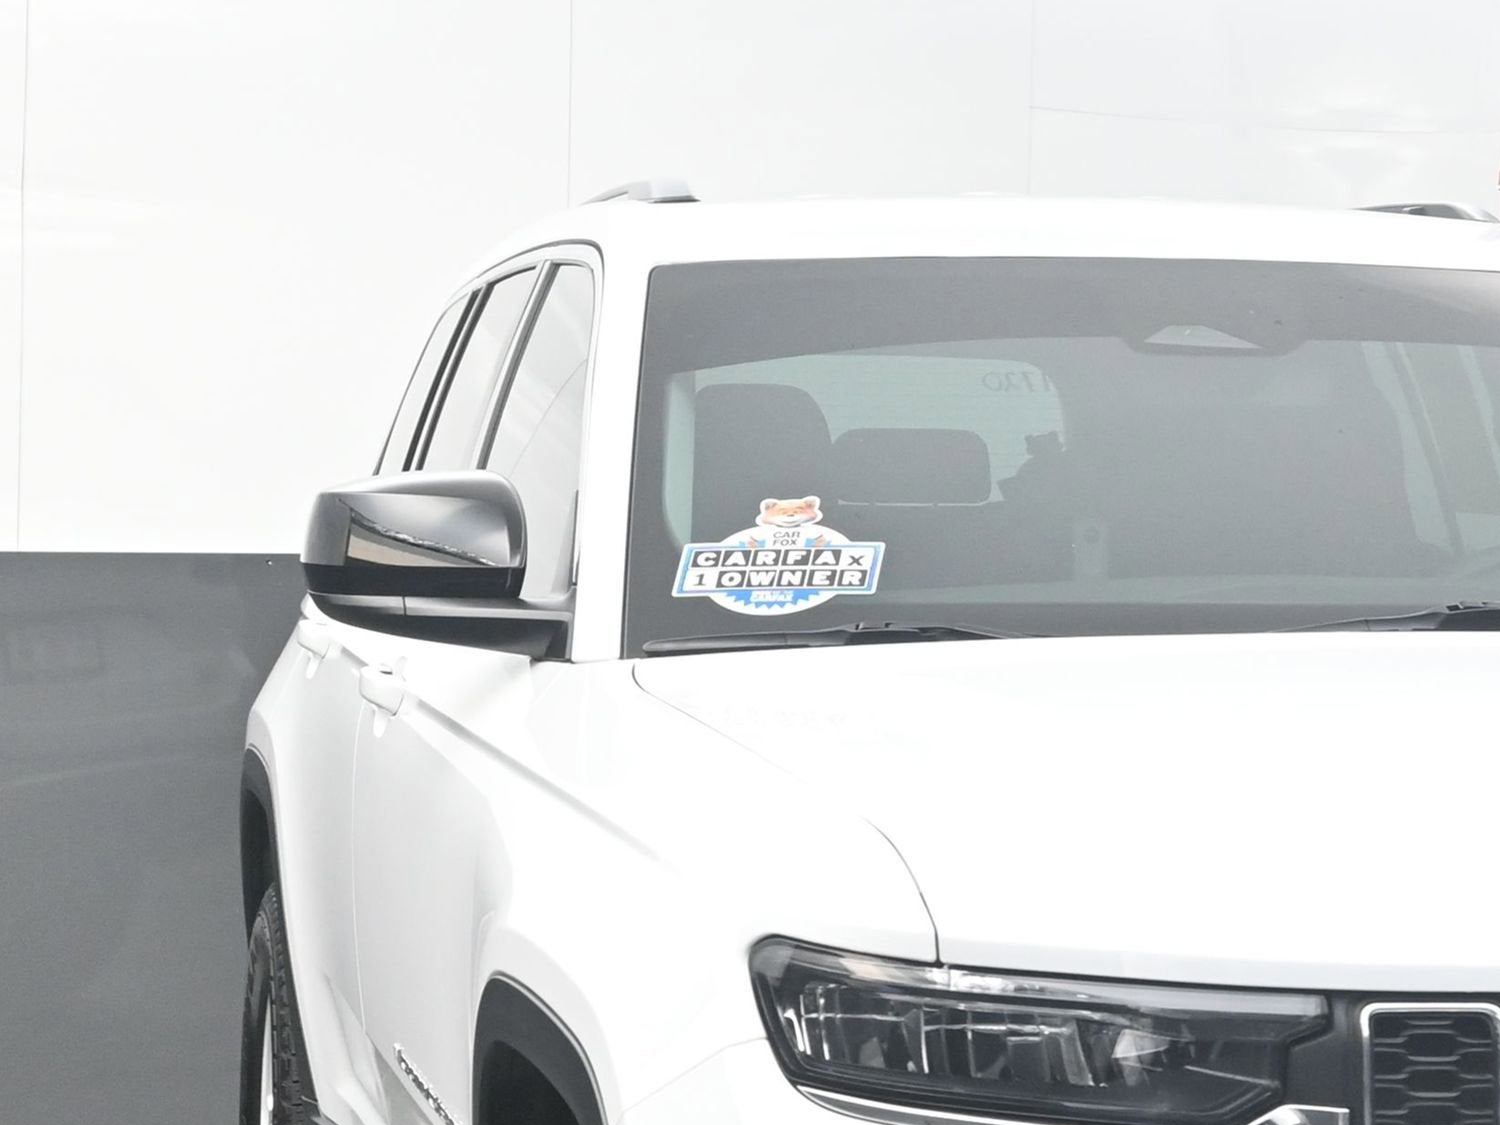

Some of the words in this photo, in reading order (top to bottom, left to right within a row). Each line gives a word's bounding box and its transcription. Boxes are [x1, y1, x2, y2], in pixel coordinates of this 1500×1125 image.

[772, 530, 801, 539] CAR
[772, 538, 798, 547] FOX
[693, 550, 866, 567] CARFAX
[692, 573, 708, 587] 1
[717, 570, 864, 588] OWNER
